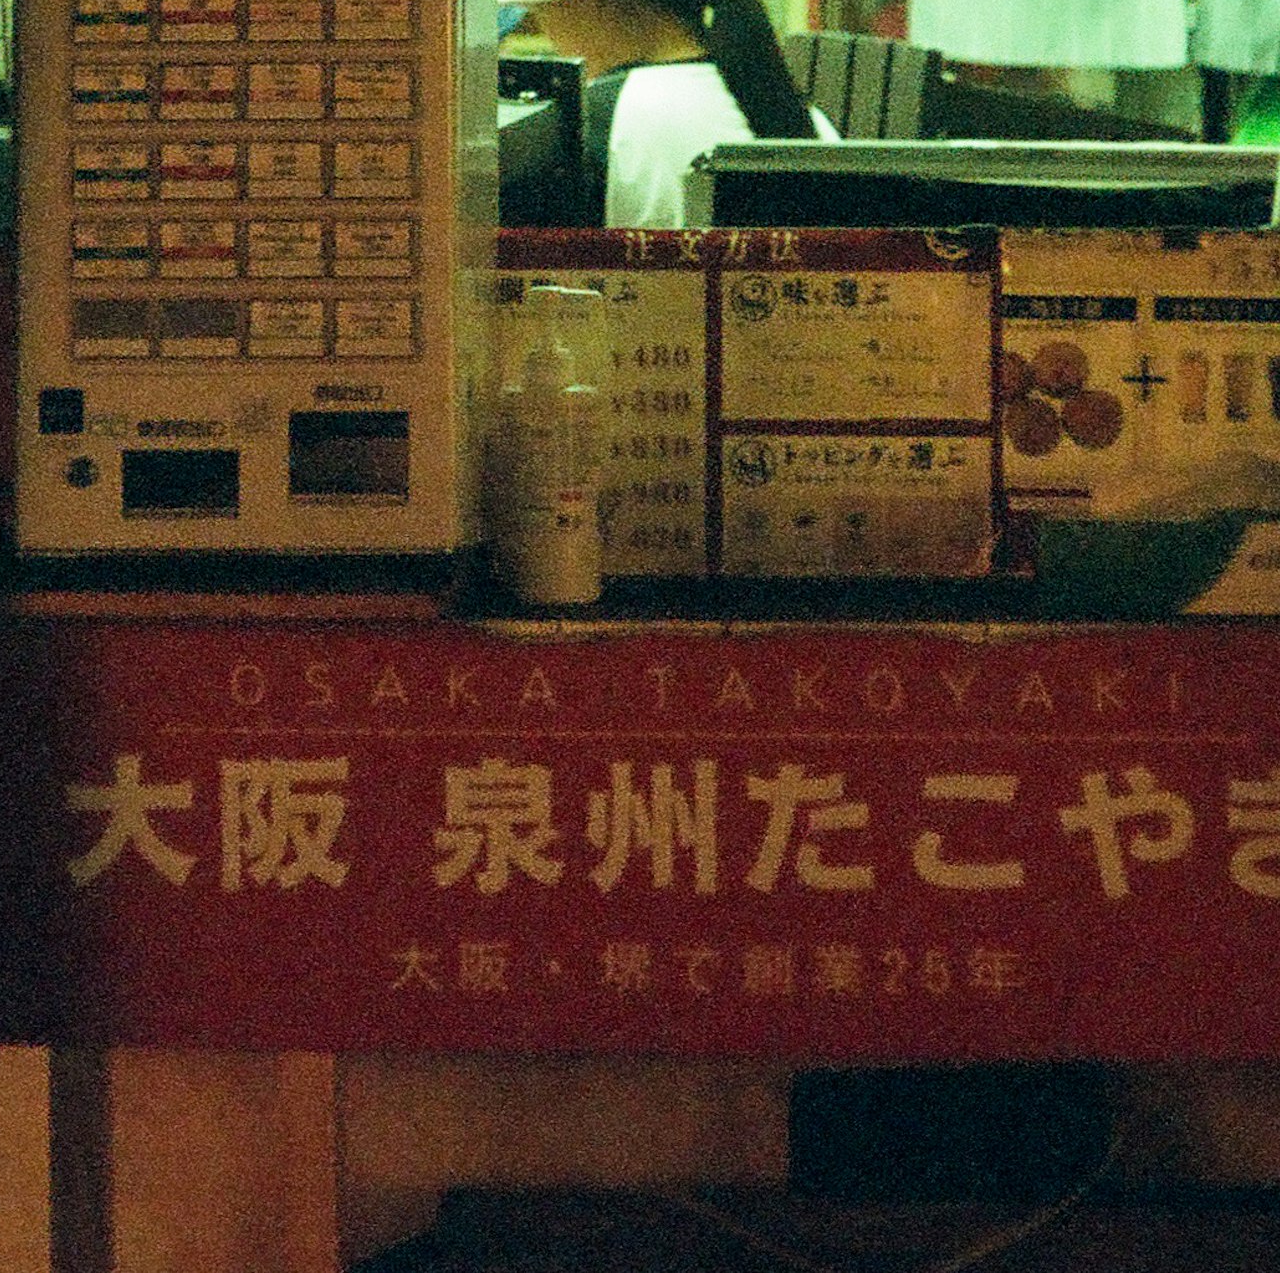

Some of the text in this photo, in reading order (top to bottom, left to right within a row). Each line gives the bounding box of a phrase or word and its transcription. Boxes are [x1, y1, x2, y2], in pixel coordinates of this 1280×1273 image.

[623, 230, 802, 263] 注文方法
[781, 277, 891, 309] 味を選ぶ
[610, 343, 692, 369] ¥480
[781, 441, 965, 471] トッピングを選ぶ
[228, 663, 1183, 713] OSAKA TAKOYAKI
[67, 756, 351, 894] 大阪
[389, 939, 1023, 996] 大阪・堺で創業25年
